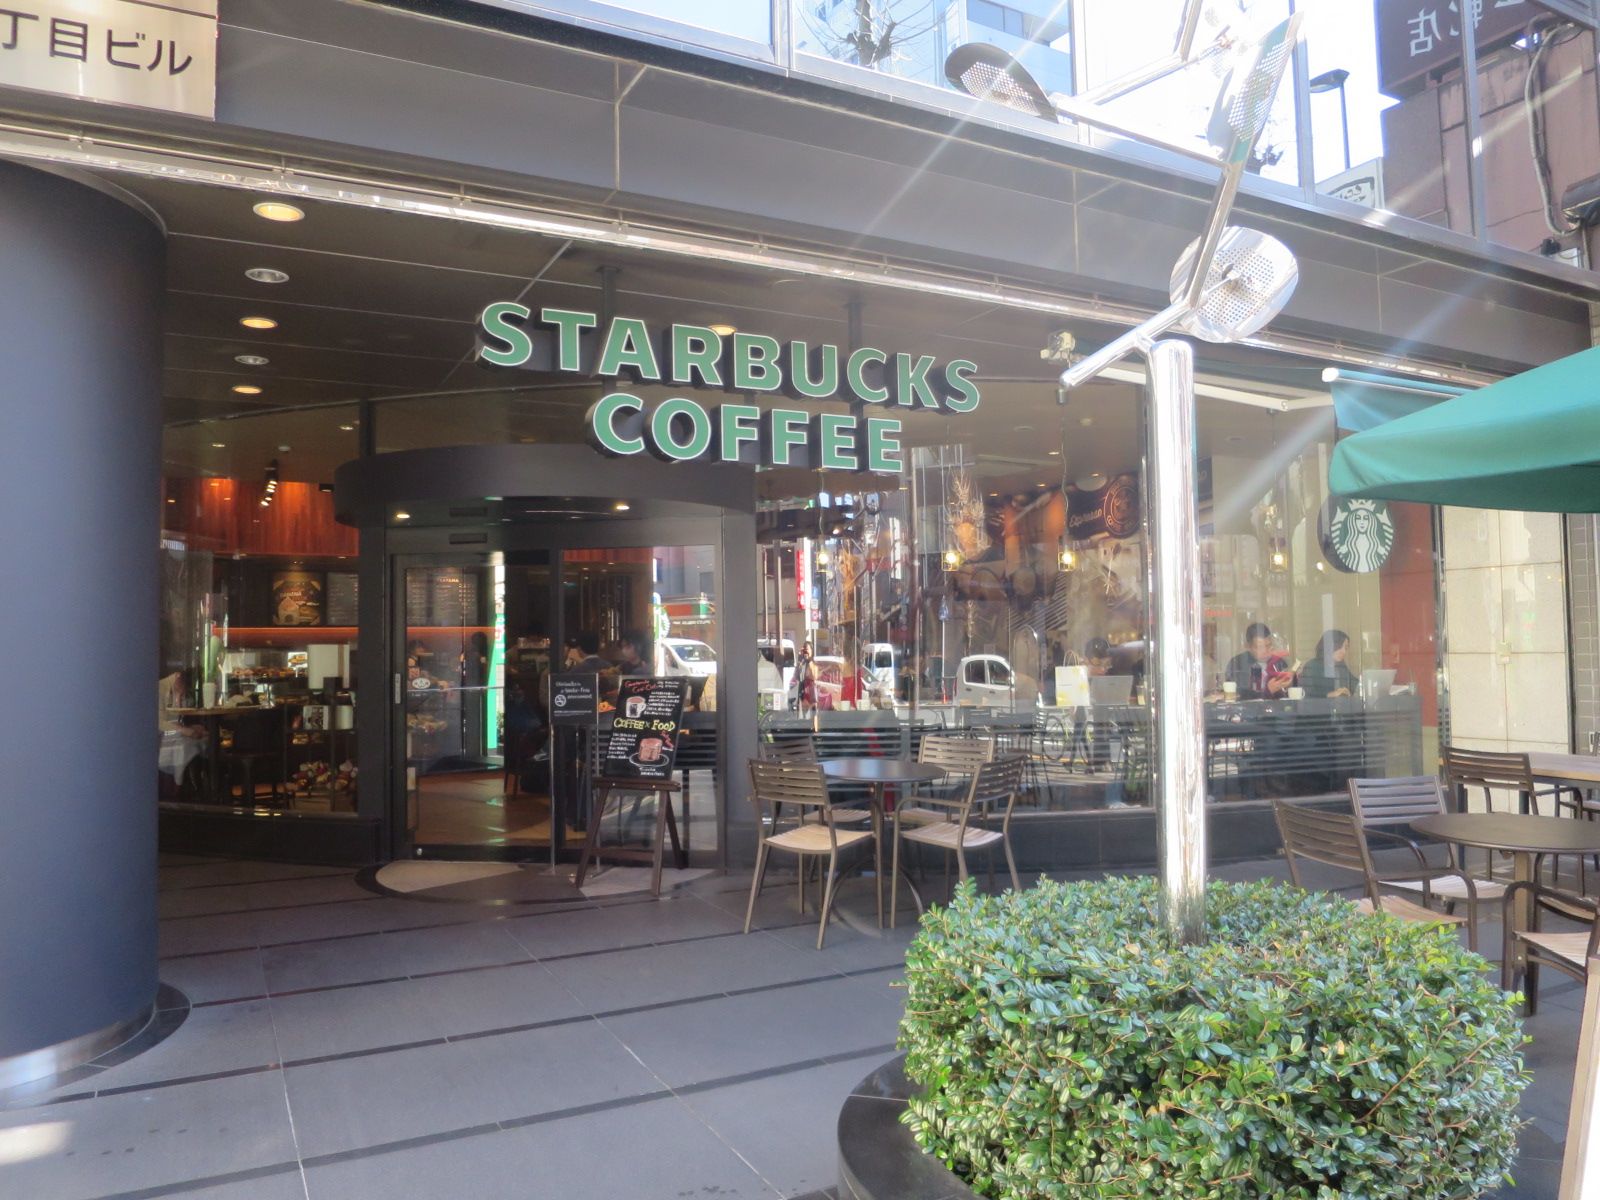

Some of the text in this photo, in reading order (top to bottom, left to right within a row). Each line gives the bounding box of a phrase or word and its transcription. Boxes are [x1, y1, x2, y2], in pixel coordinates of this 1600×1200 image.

[0, 8, 193, 76] 丁目ビル
[479, 301, 981, 414] STARBUCKS
[592, 392, 903, 473] COFFEE
